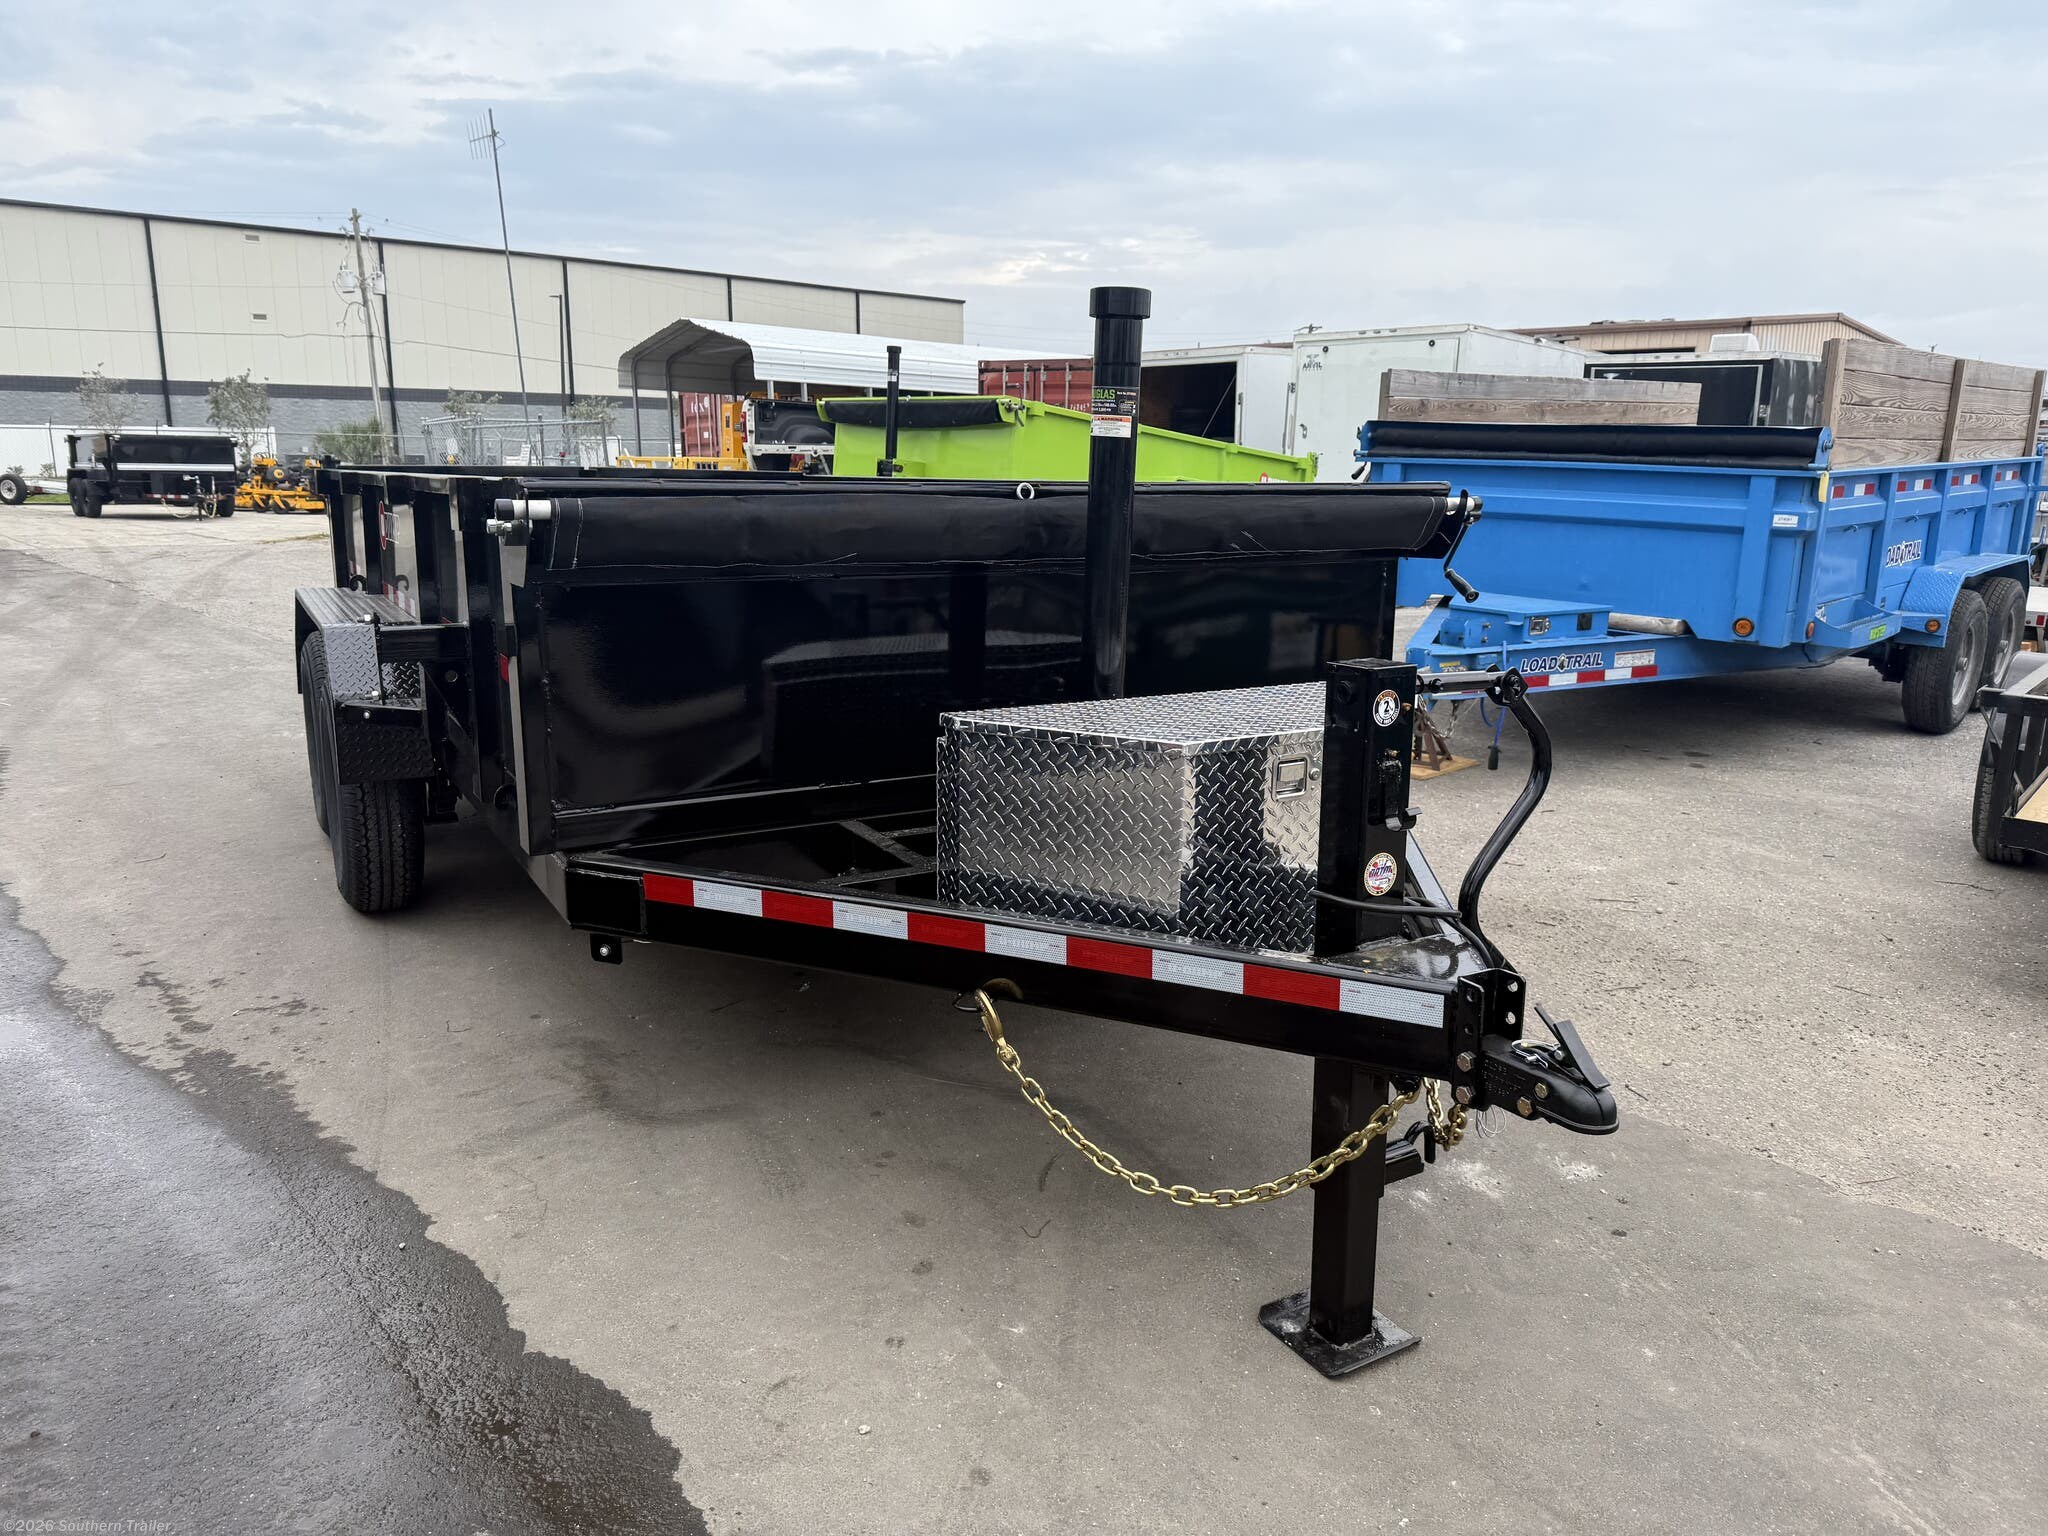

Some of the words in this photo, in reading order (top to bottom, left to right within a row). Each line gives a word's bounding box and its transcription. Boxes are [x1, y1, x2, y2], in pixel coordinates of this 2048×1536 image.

[1885, 545, 1901, 568] OAD
[1520, 656, 1559, 673] LOAD
[1565, 651, 1604, 669] TRAIL
